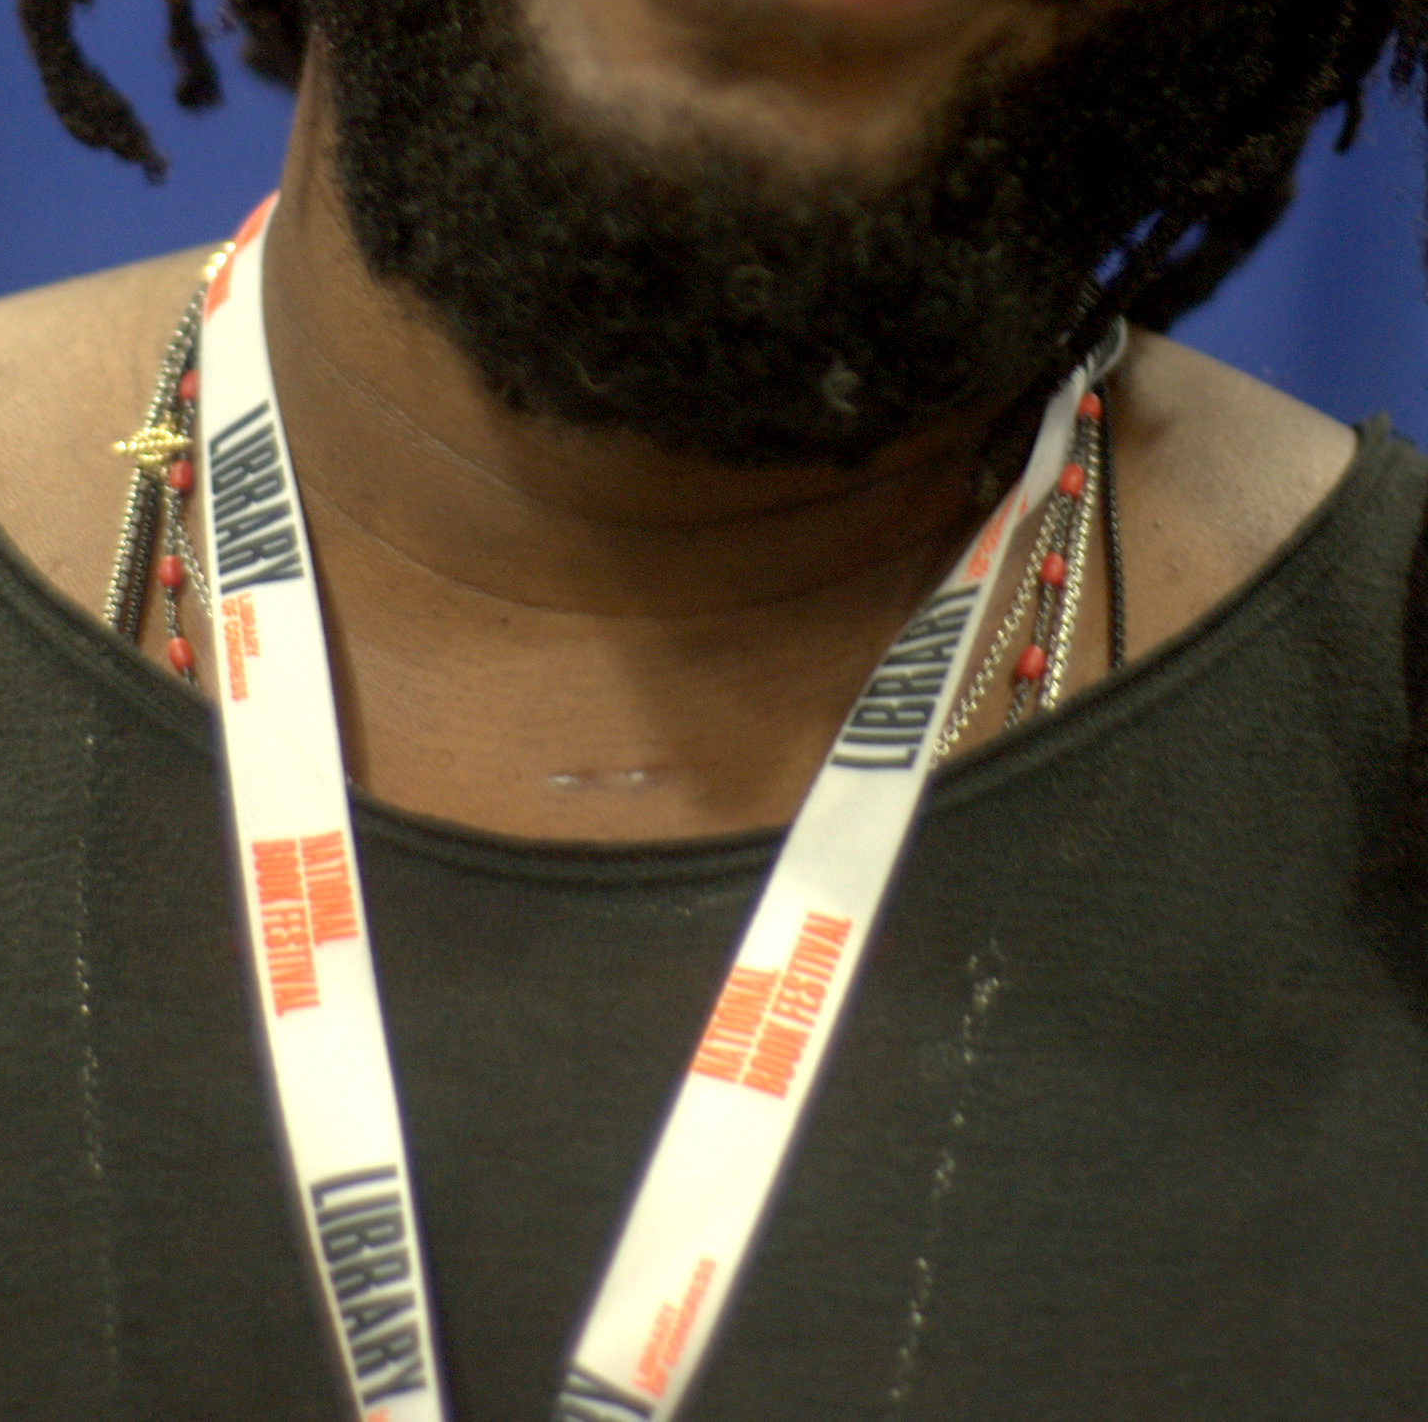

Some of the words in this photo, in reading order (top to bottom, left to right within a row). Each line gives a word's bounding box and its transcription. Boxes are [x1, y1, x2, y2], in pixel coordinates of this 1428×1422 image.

[209, 399, 306, 595] LIBRARY
[828, 582, 980, 770] LIBRARY
[299, 829, 360, 948] NATIONAL
[260, 906, 322, 1019] FESTIVAL
[771, 911, 853, 1028] FESTIVAL
[691, 964, 781, 1085] NATIONAL
[741, 1019, 810, 1101] BOOK
[309, 1163, 428, 1407] LIBRARY
